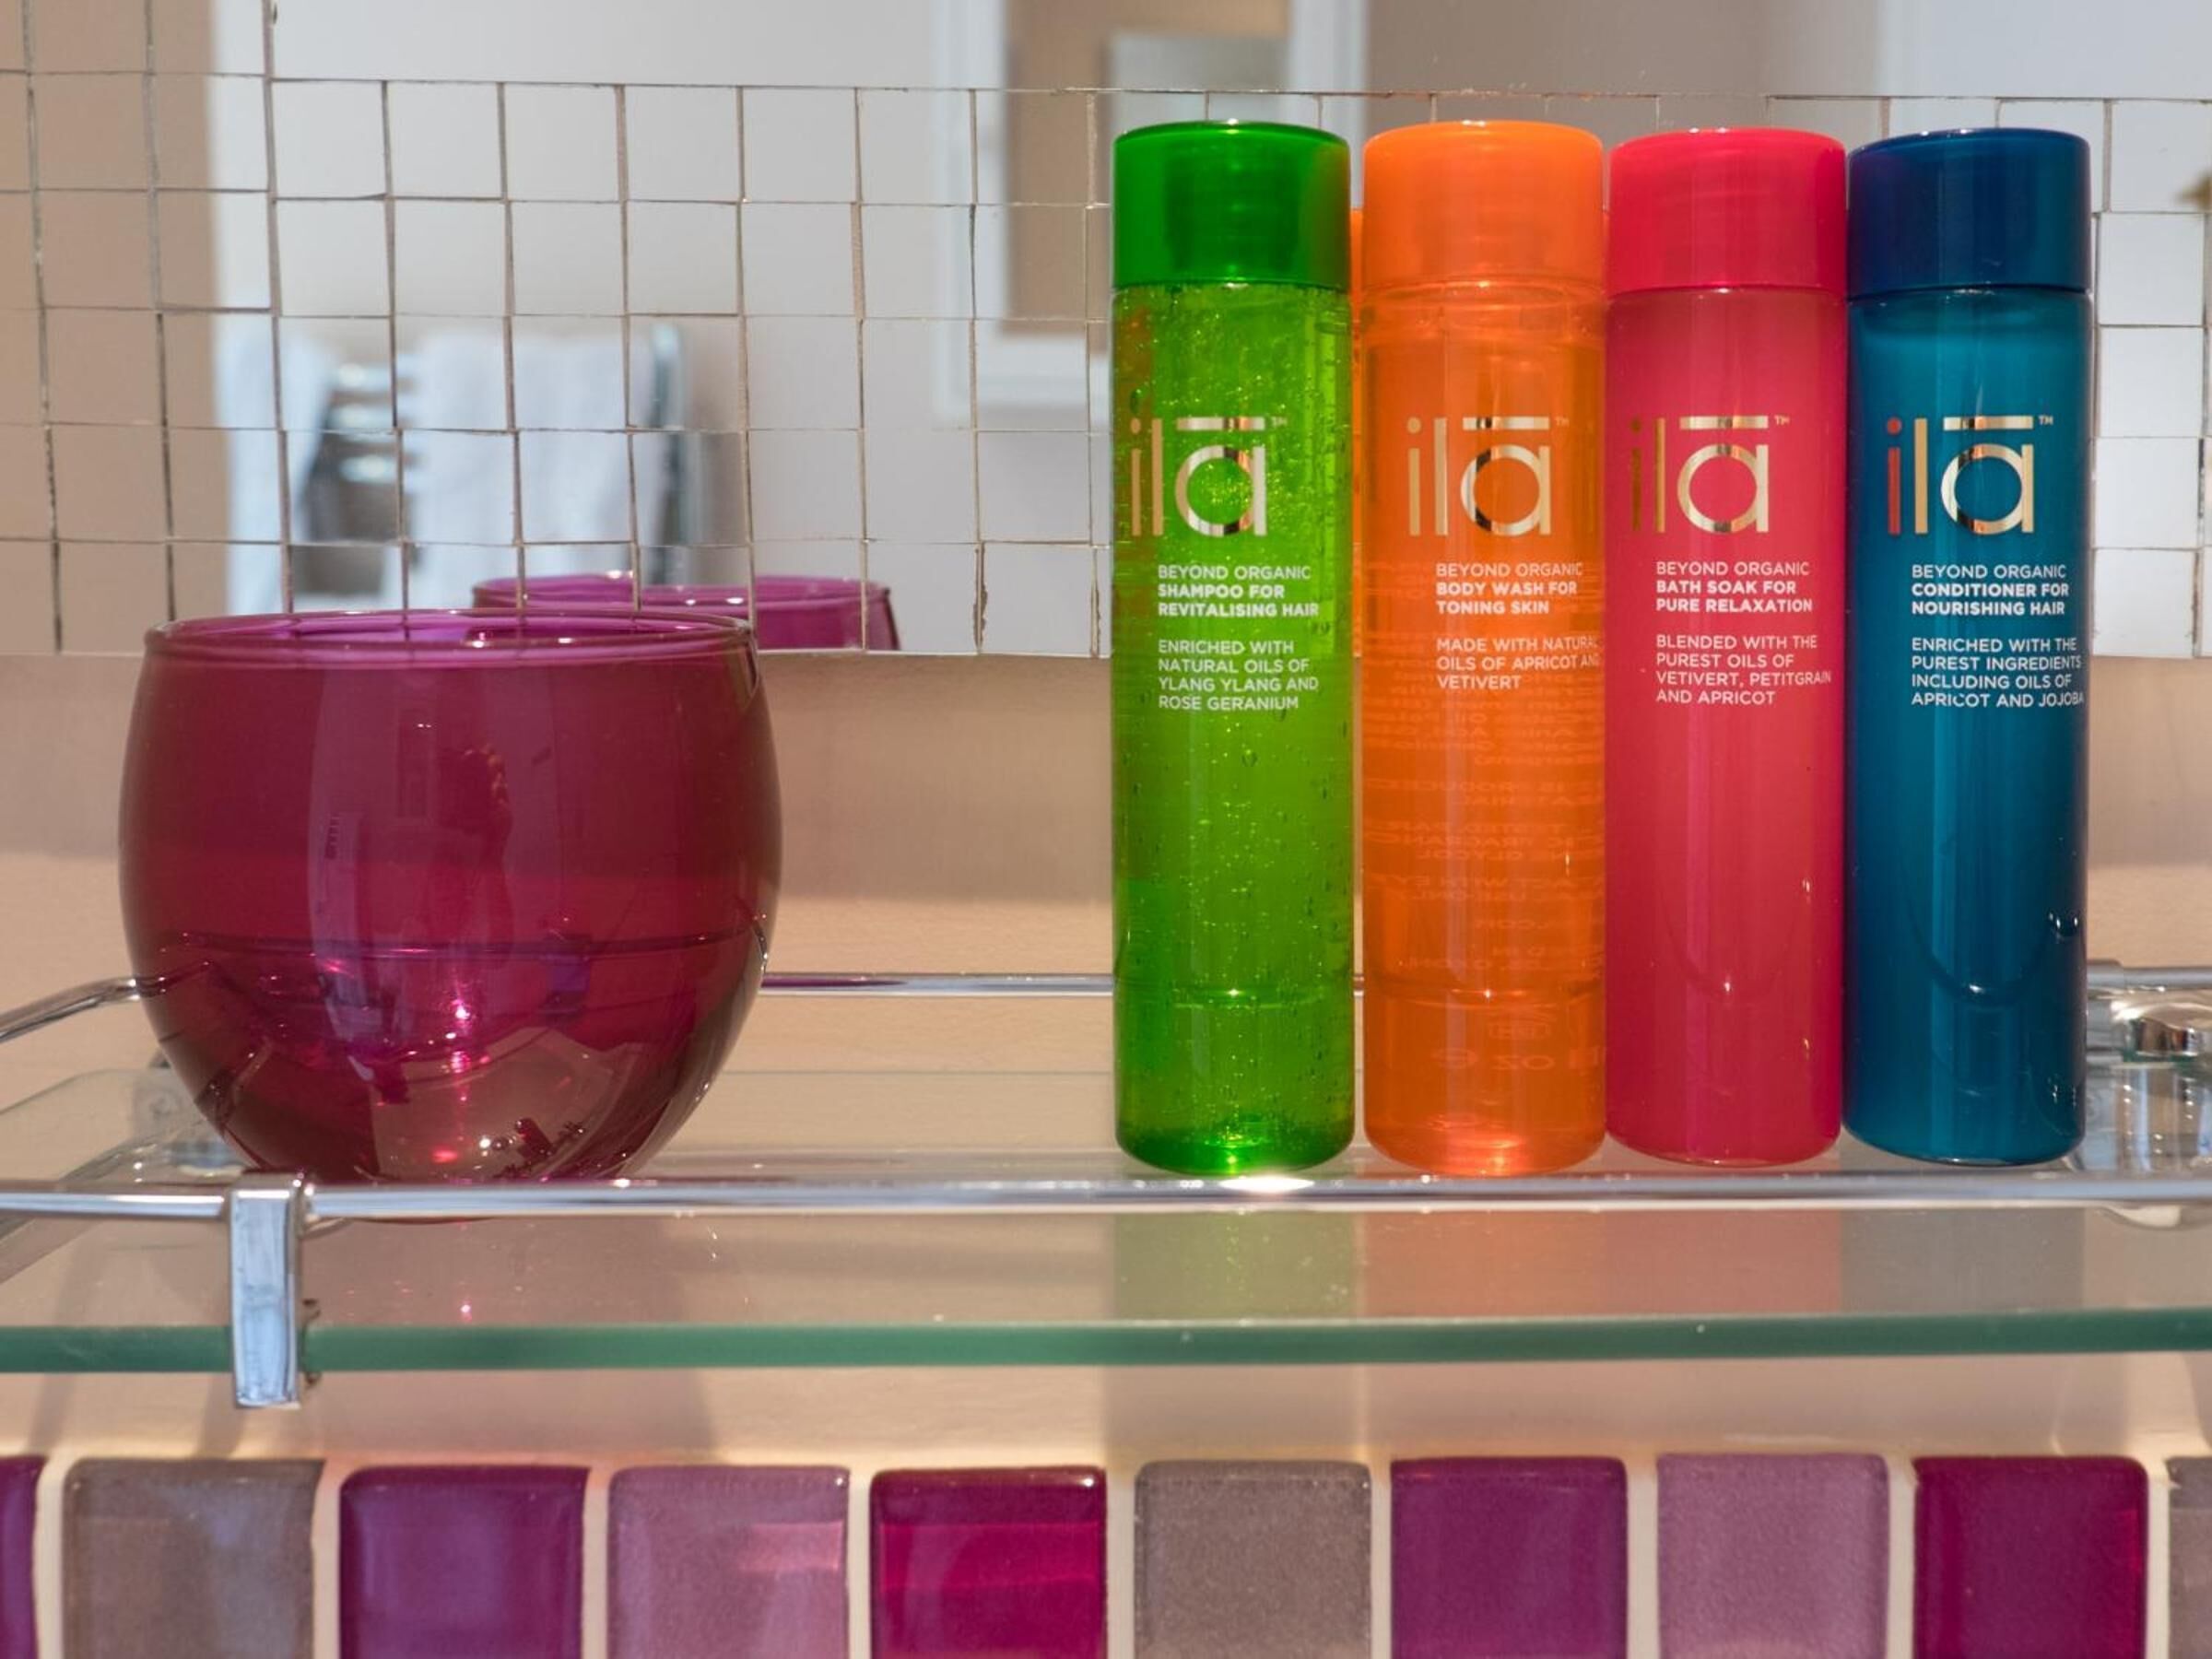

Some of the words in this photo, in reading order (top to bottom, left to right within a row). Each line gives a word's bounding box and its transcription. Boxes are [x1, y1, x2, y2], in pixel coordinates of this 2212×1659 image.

[1159, 565, 1228, 580] BEYOND
[1234, 566, 1312, 580] ORGANIC
[1435, 562, 1511, 577] BEYOND
[1515, 562, 1583, 577] ORGANIC
[1656, 561, 1729, 576] BEYOND
[1734, 561, 1810, 576] ORGANIC
[1912, 564, 1988, 579] BEYOND
[1994, 564, 2066, 579] ORGANIC
[1158, 584, 1244, 598] SHAMPOO
[1249, 584, 1285, 598] FOR
[1435, 582, 1486, 595] BODY
[1492, 582, 1544, 595] WASH
[1548, 581, 1578, 594] FOR
[1656, 580, 1701, 594] BATH
[1706, 580, 1758, 594] SOAK
[1763, 581, 1796, 594] FOR
[1911, 583, 2037, 597] CONDITIONER
[2041, 583, 2069, 597] FOR
[1159, 603, 1277, 617] REVITALISING
[1282, 604, 1320, 618] HAIR
[1436, 600, 1505, 615] TONING
[1511, 601, 1549, 614] SKIN
[1656, 598, 1700, 613] PURE
[1705, 598, 1812, 613] RELAXATION
[1912, 601, 2025, 615] NOURISHING
[2030, 601, 2065, 615] HAIR
[1159, 640, 1245, 654] ENRICHED
[1250, 641, 1294, 654] WITH
[1436, 637, 1487, 652] MADE
[1492, 637, 1537, 652] WITH
[1656, 634, 1737, 649] BLENDED
[1743, 634, 1787, 649] WITH
[1793, 634, 1818, 649] THE
[1912, 637, 2004, 653] ENRICHED
[2008, 638, 2051, 653] WITH
[2055, 637, 2077, 652] THE
[1159, 659, 1239, 673] NATURAL
[1244, 659, 1284, 673] OILS
[1288, 659, 1310, 673] OF
[1437, 656, 1476, 670] OILS
[1481, 656, 1505, 670] OF
[1512, 654, 1578, 670] APRICOT
[1656, 653, 1722, 667] PUREST
[1726, 653, 1767, 668] OILS
[1772, 653, 1794, 667] OF
[1912, 656, 1981, 670] PUREST
[1986, 654, 2083, 670] INGREDIENTS
[1159, 677, 1216, 692] YLANG
[1220, 677, 1281, 692] YLANG
[1286, 677, 1318, 691] AND
[1437, 675, 1522, 689] VETIVERT
[1656, 671, 1744, 688] VETIVERT,
[1749, 671, 1832, 687] PETITGRAIN
[1912, 674, 2010, 689] INCLUDING
[2015, 675, 2052, 689] OILS
[2055, 674, 2072, 688] OF
[1159, 696, 1201, 710] ROSE
[1206, 696, 1300, 710] GERANIUM
[1656, 689, 1692, 704] AND
[1698, 690, 1775, 705] APRICOT
[1911, 692, 1990, 707] APRICOT
[1996, 693, 2034, 708] AND
[2039, 691, 2084, 707] JOJOBA
